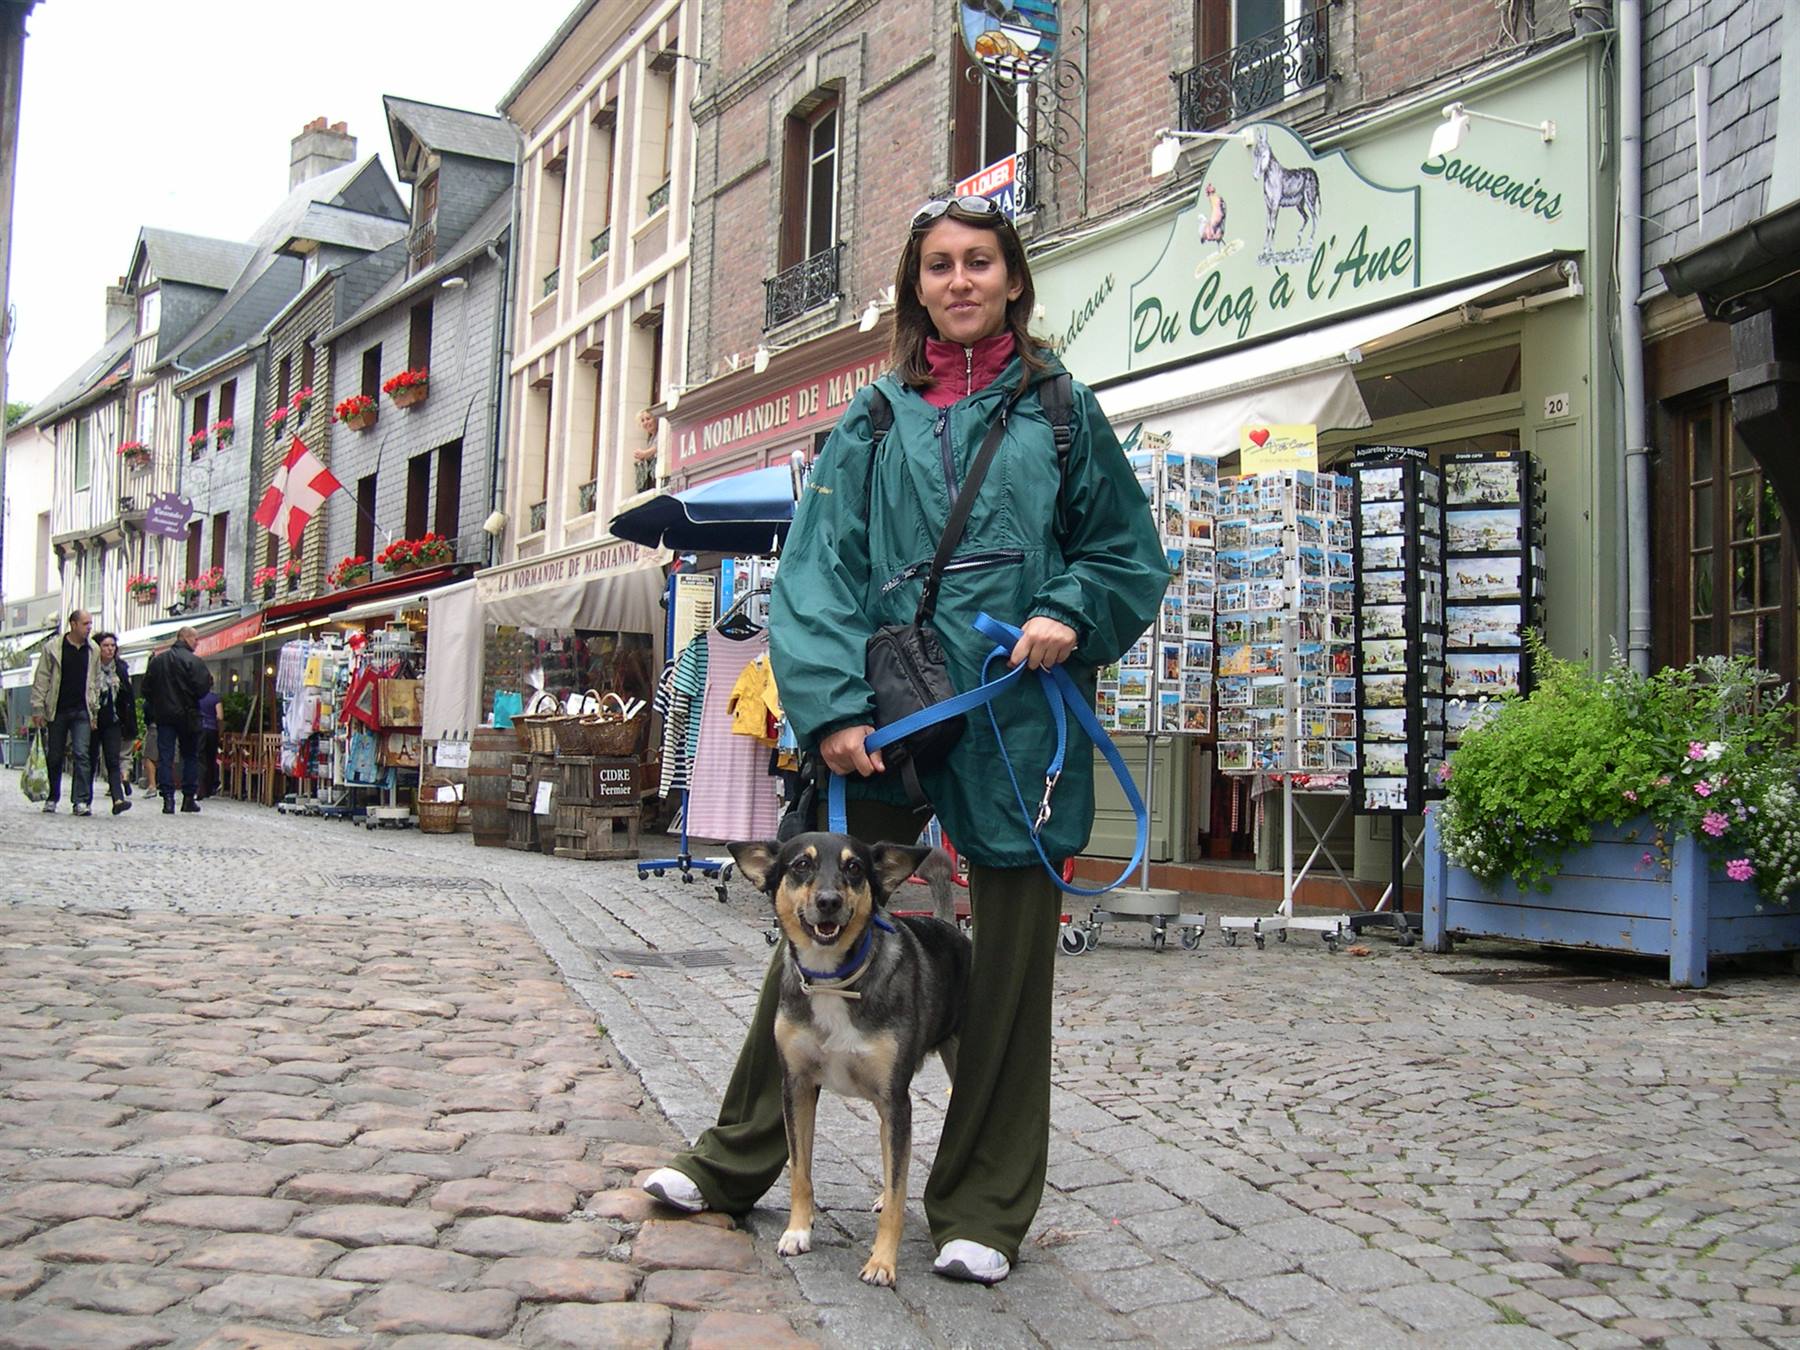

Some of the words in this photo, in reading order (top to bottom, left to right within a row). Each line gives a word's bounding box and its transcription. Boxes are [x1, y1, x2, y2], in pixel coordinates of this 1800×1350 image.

[972, 163, 1009, 198] LOUER
[1133, 296, 1181, 353] Du
[1189, 270, 1257, 339] Coq
[1269, 265, 1294, 310] à
[1307, 225, 1413, 300] l'Ane
[680, 433, 697, 459] LA
[703, 394, 790, 452] NORMANDIE
[797, 382, 819, 418] DE
[1549, 400, 1563, 414] 20
[499, 574, 509, 593] LA
[513, 561, 564, 590] NORMANDIE
[568, 556, 581, 577] DE
[583, 542, 641, 574] MARIANNE
[600, 769, 631, 781] CIDRE
[600, 783, 631, 795] Fermier
